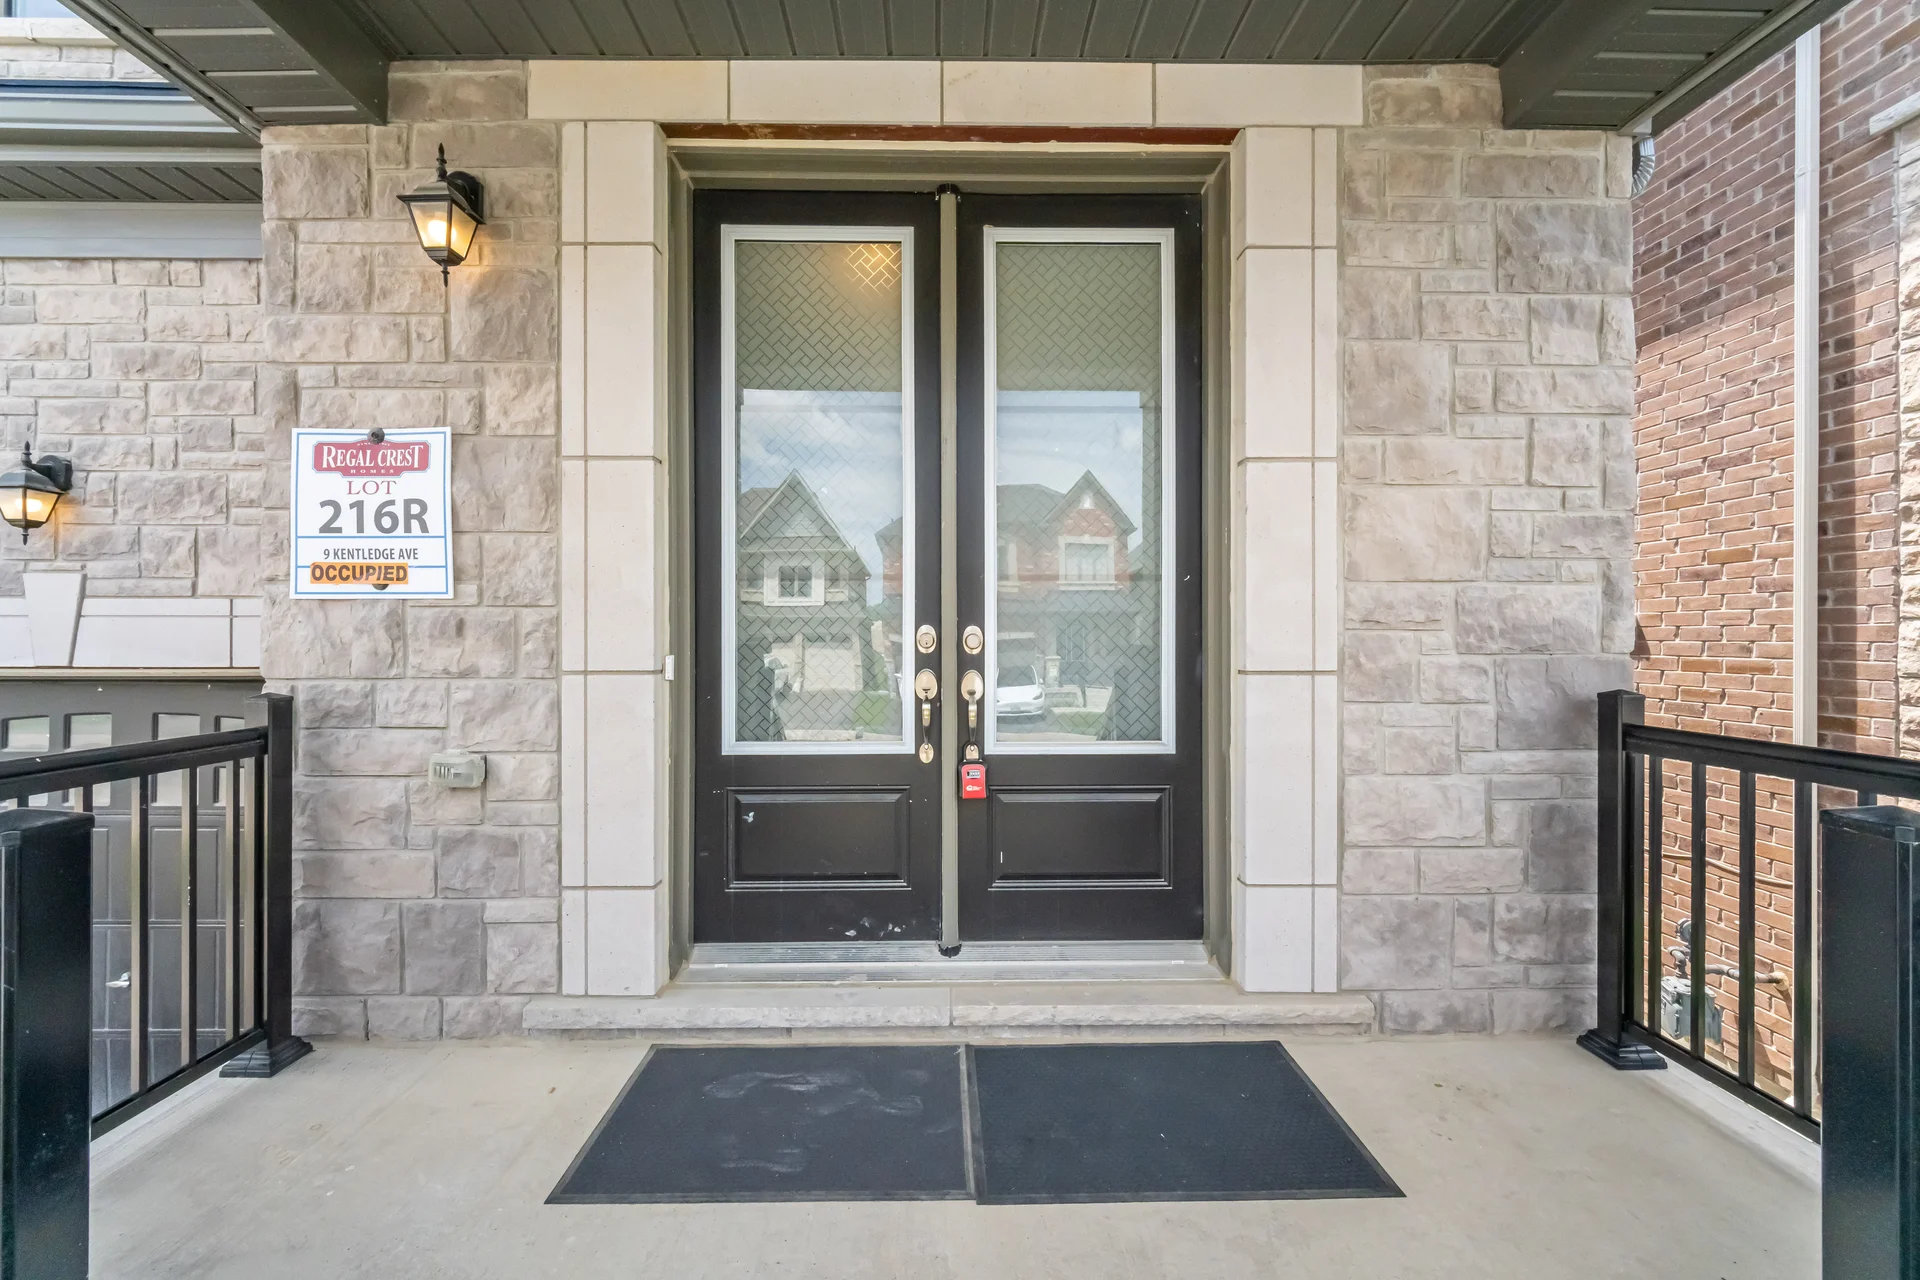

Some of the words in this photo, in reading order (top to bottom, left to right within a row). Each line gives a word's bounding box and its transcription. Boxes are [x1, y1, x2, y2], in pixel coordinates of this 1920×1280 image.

[322, 445, 375, 468] REGAL
[377, 445, 424, 468] CREST
[346, 480, 397, 495] LOT
[318, 498, 430, 534] 216R
[323, 548, 330, 560] 9
[333, 548, 395, 560] KENTLEDGE
[398, 548, 419, 560] AVE
[311, 564, 408, 582] OCCUPIED
